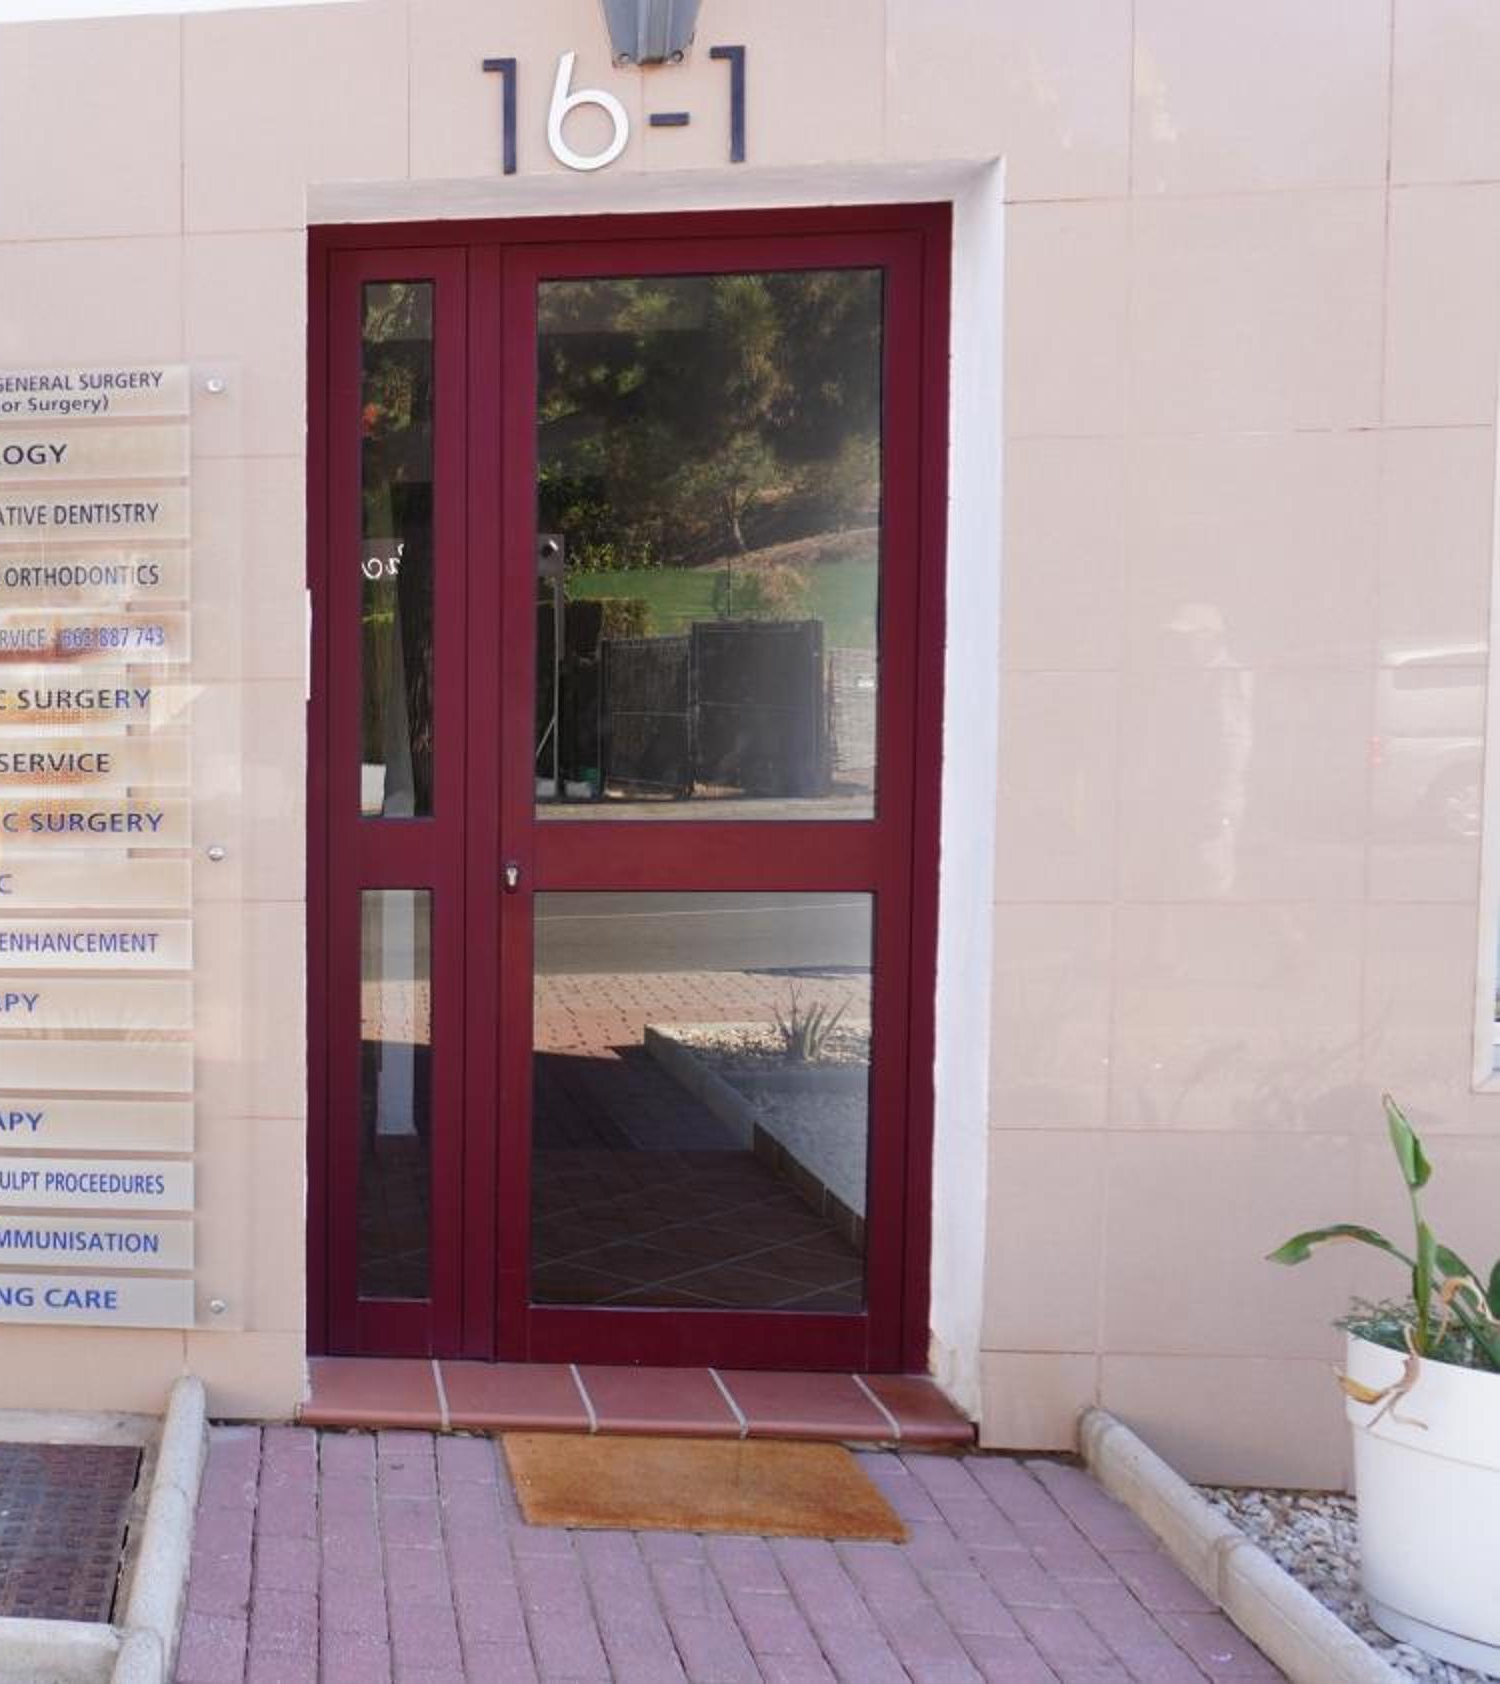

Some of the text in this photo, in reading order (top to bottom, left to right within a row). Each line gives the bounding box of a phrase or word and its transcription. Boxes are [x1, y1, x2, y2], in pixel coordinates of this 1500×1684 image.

[78, 371, 163, 391] SURGERY
[27, 393, 109, 415] Surgery)
[53, 502, 159, 526] DENTISTRY
[3, 564, 160, 588] ORTHODONTICS
[16, 688, 152, 711] SURGERY
[26, 812, 165, 833] SURGERY
[44, 1171, 165, 1195] PROCEEDURES
[43, 1288, 118, 1311] CARE
